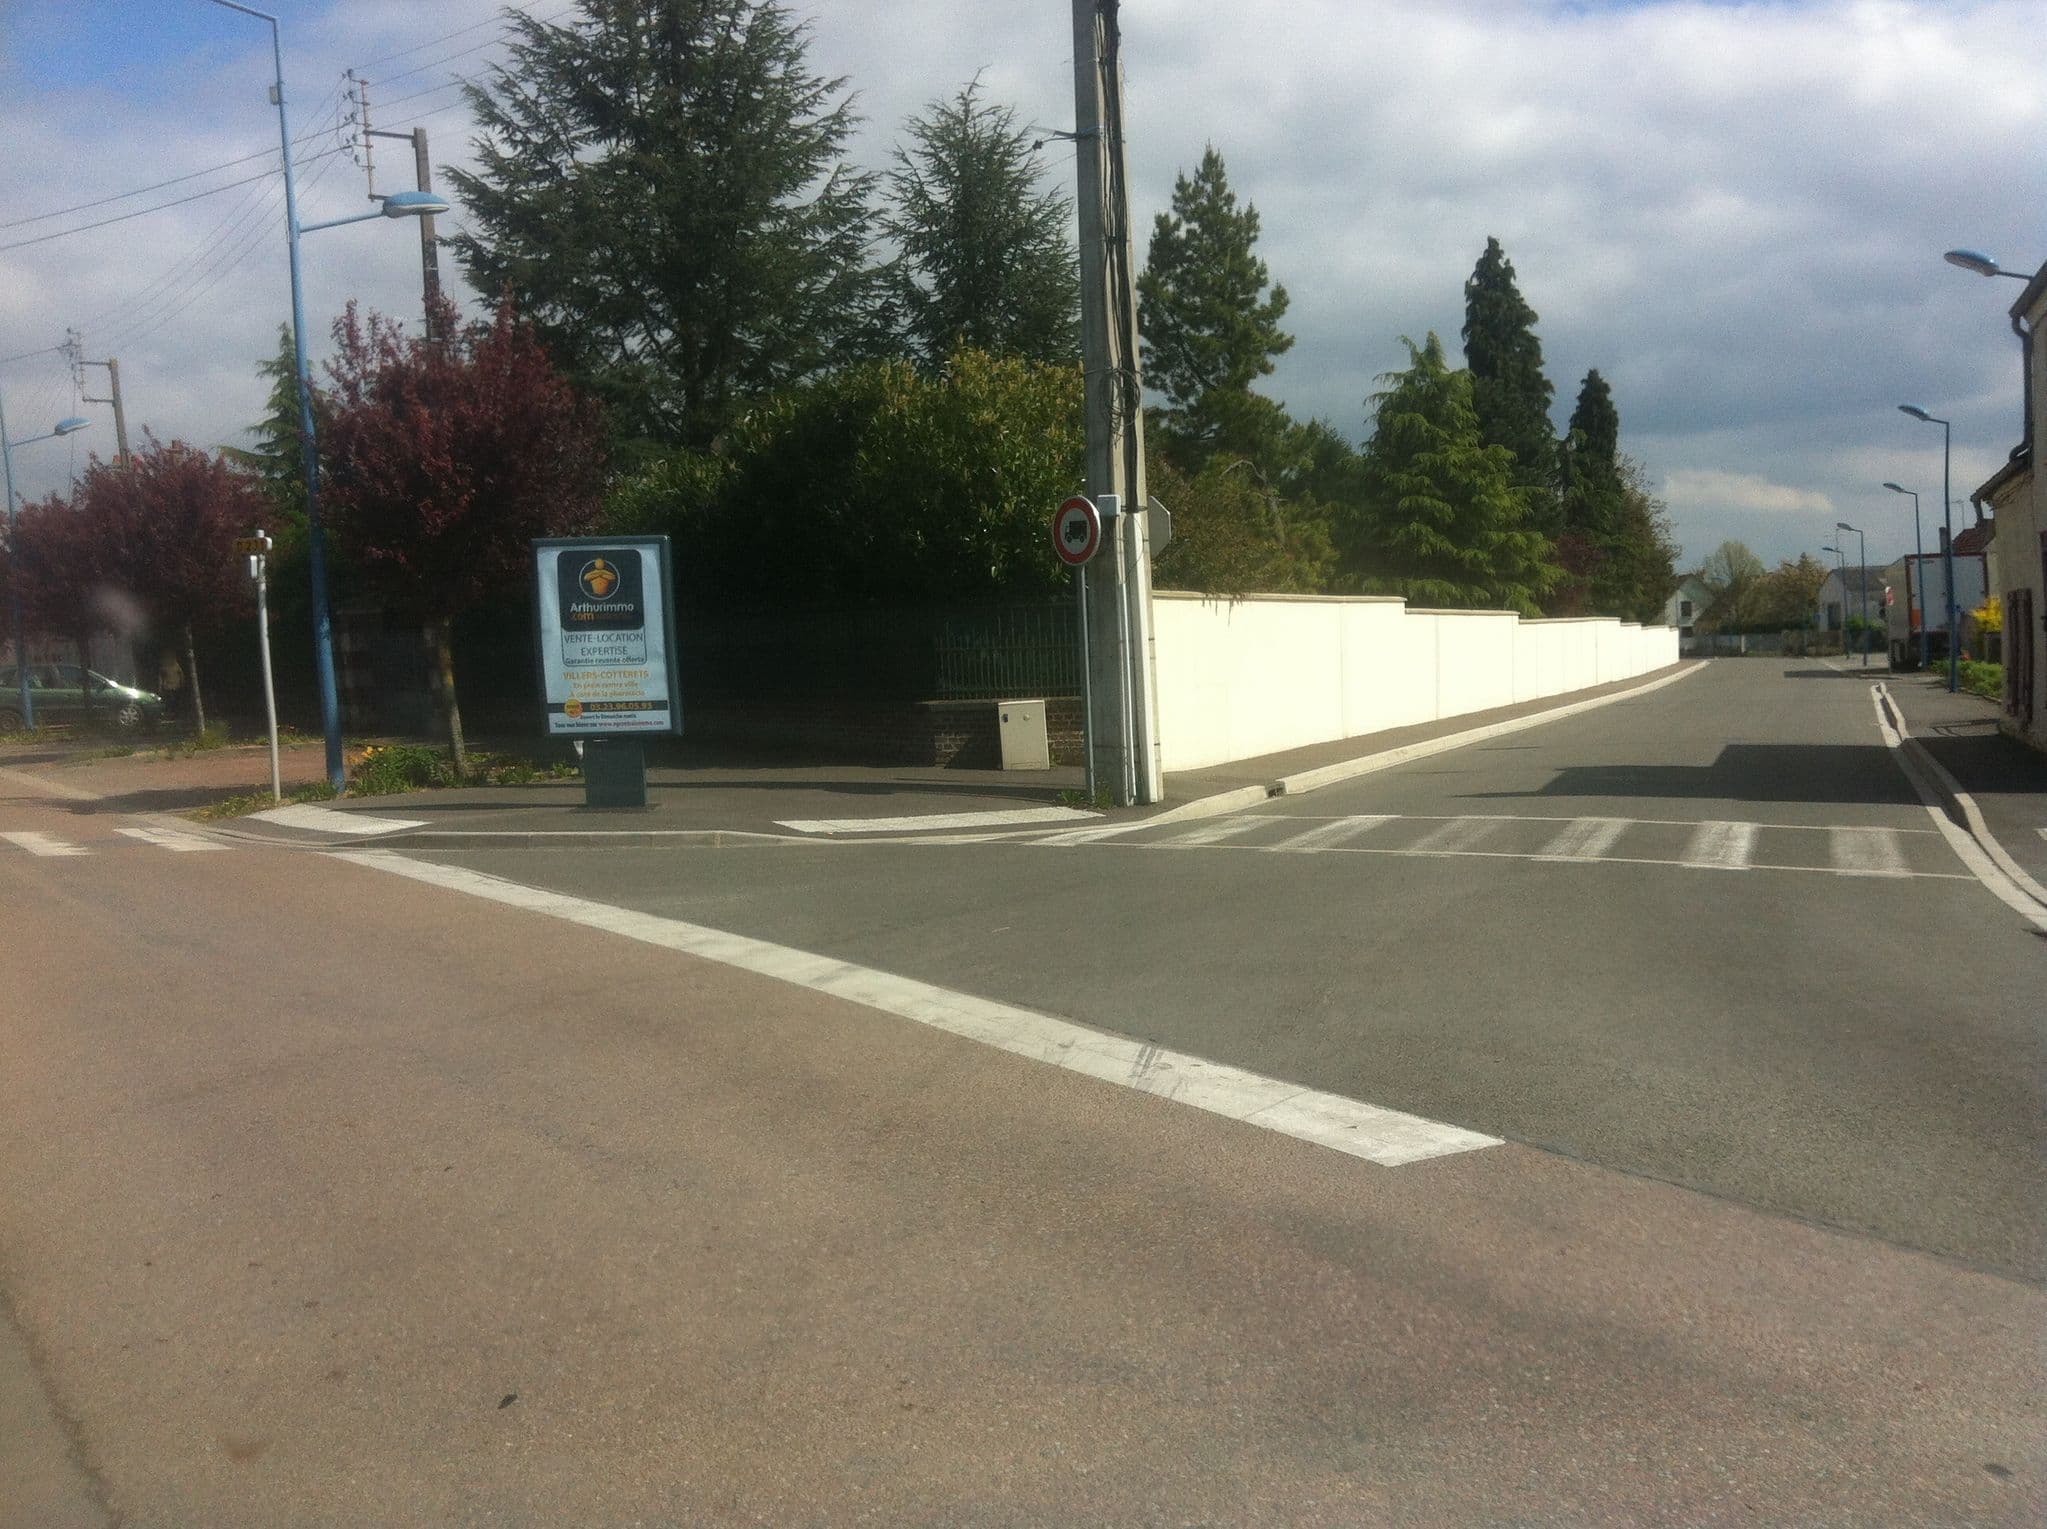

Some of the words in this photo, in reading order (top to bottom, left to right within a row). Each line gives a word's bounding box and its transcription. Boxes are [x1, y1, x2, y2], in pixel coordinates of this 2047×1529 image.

[570, 602, 634, 613] Arthurimmo
[580, 646, 628, 656] EXPERTISE
[565, 657, 594, 665] Garantie
